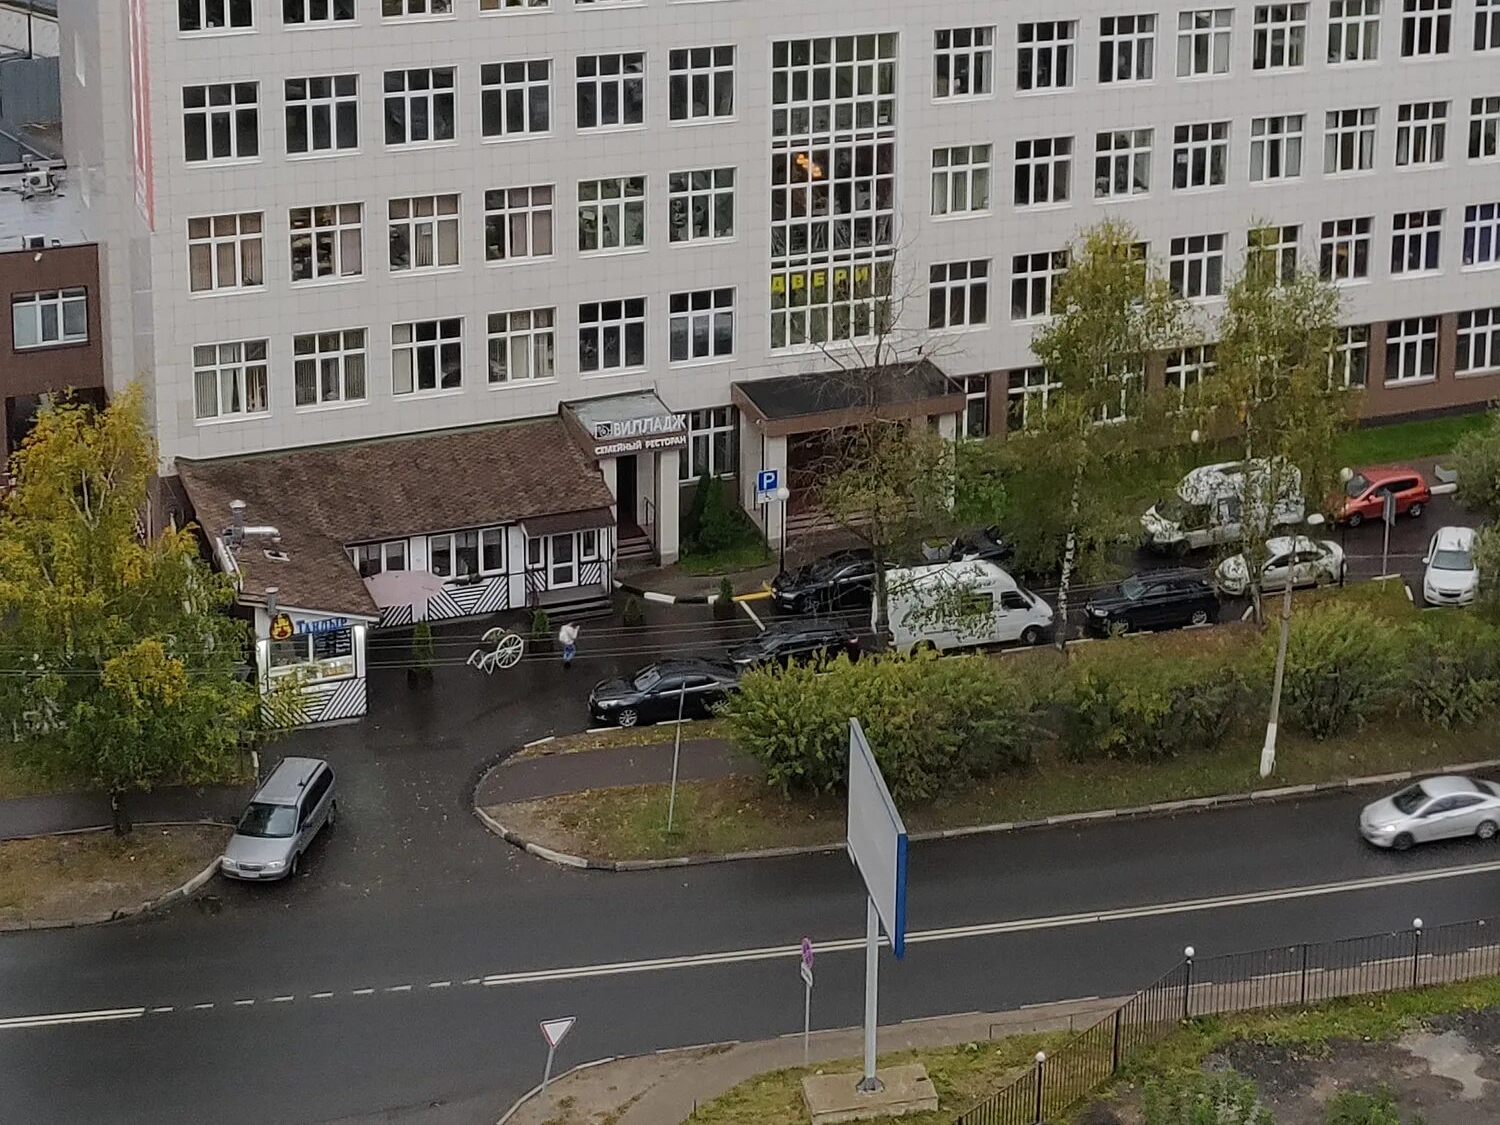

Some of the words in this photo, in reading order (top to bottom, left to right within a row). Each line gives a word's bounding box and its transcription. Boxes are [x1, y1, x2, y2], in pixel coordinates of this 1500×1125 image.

[771, 266, 869, 293] ДВЕРИ
[613, 414, 686, 436] ВИЛЛАДЖ
[594, 440, 642, 455] СЕМЕЙНЫЙ
[645, 435, 686, 449] РЕСТОРАН
[763, 472, 775, 490] P
